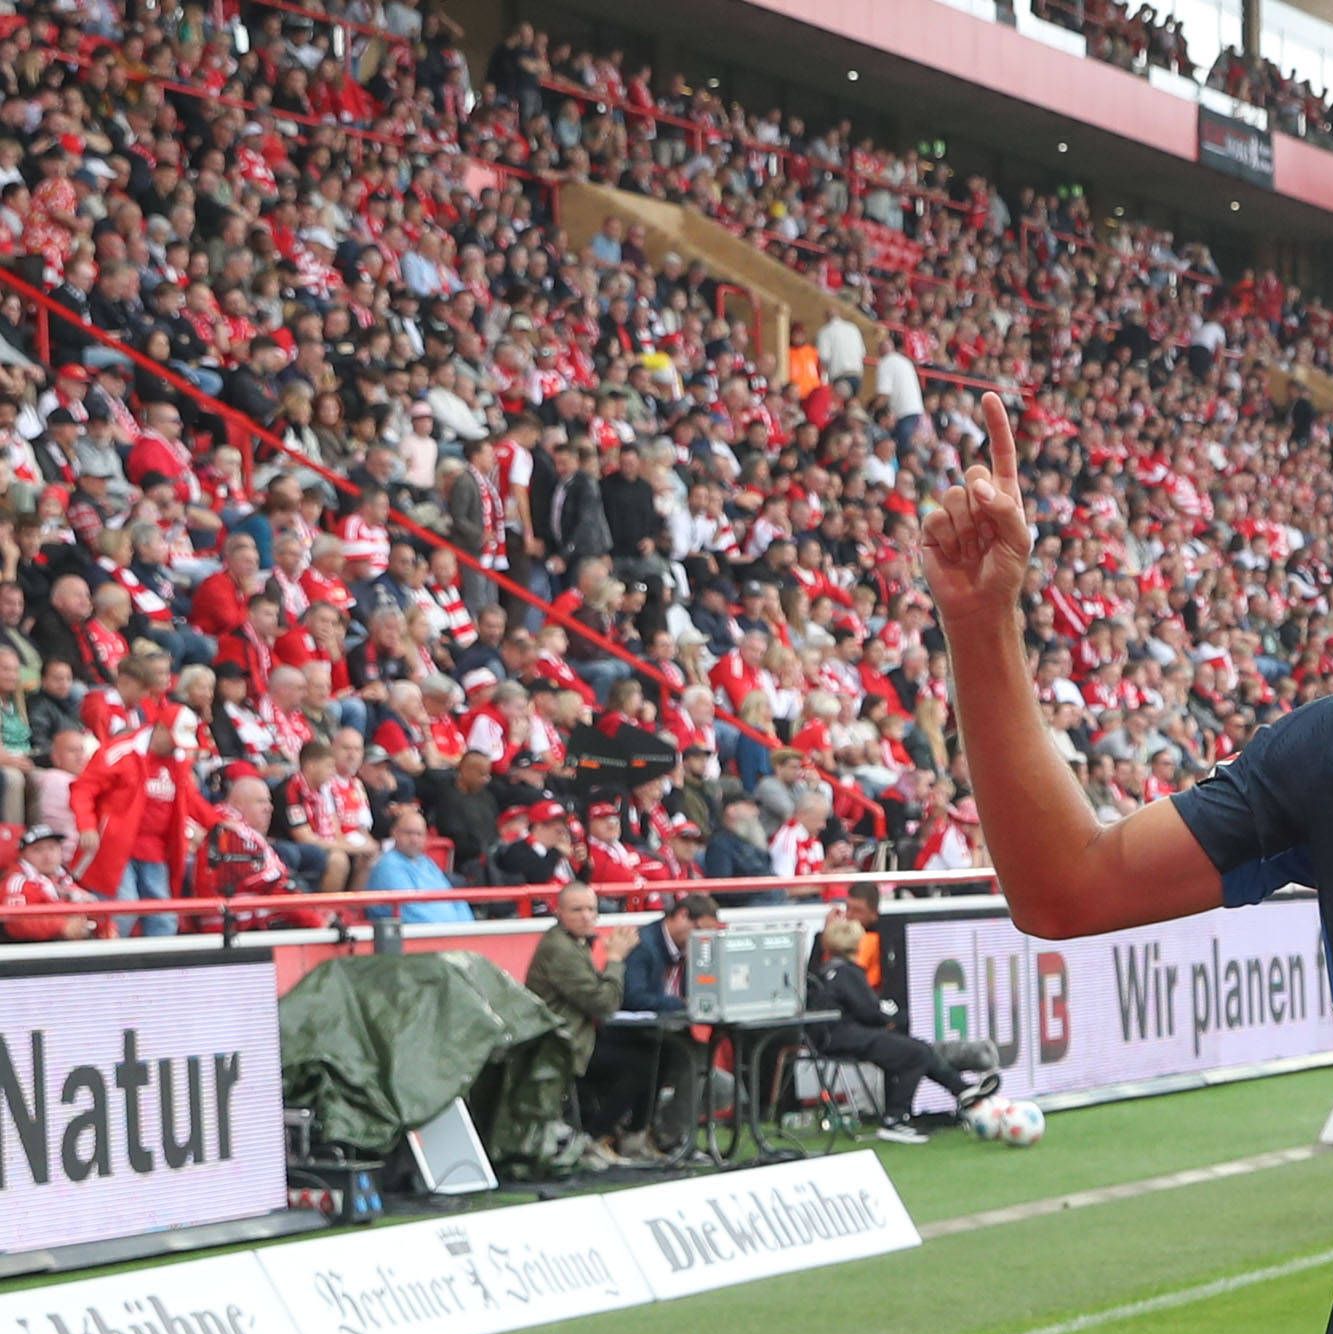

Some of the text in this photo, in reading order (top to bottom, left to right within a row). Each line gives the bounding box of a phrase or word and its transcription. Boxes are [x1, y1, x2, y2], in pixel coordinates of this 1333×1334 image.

[933, 951, 1070, 1069] GUB
[1113, 943, 1179, 1042] Wir
[1192, 937, 1307, 1059] planen
[0, 1027, 240, 1191] Natur
[487, 1241, 620, 1302] Zeitung
